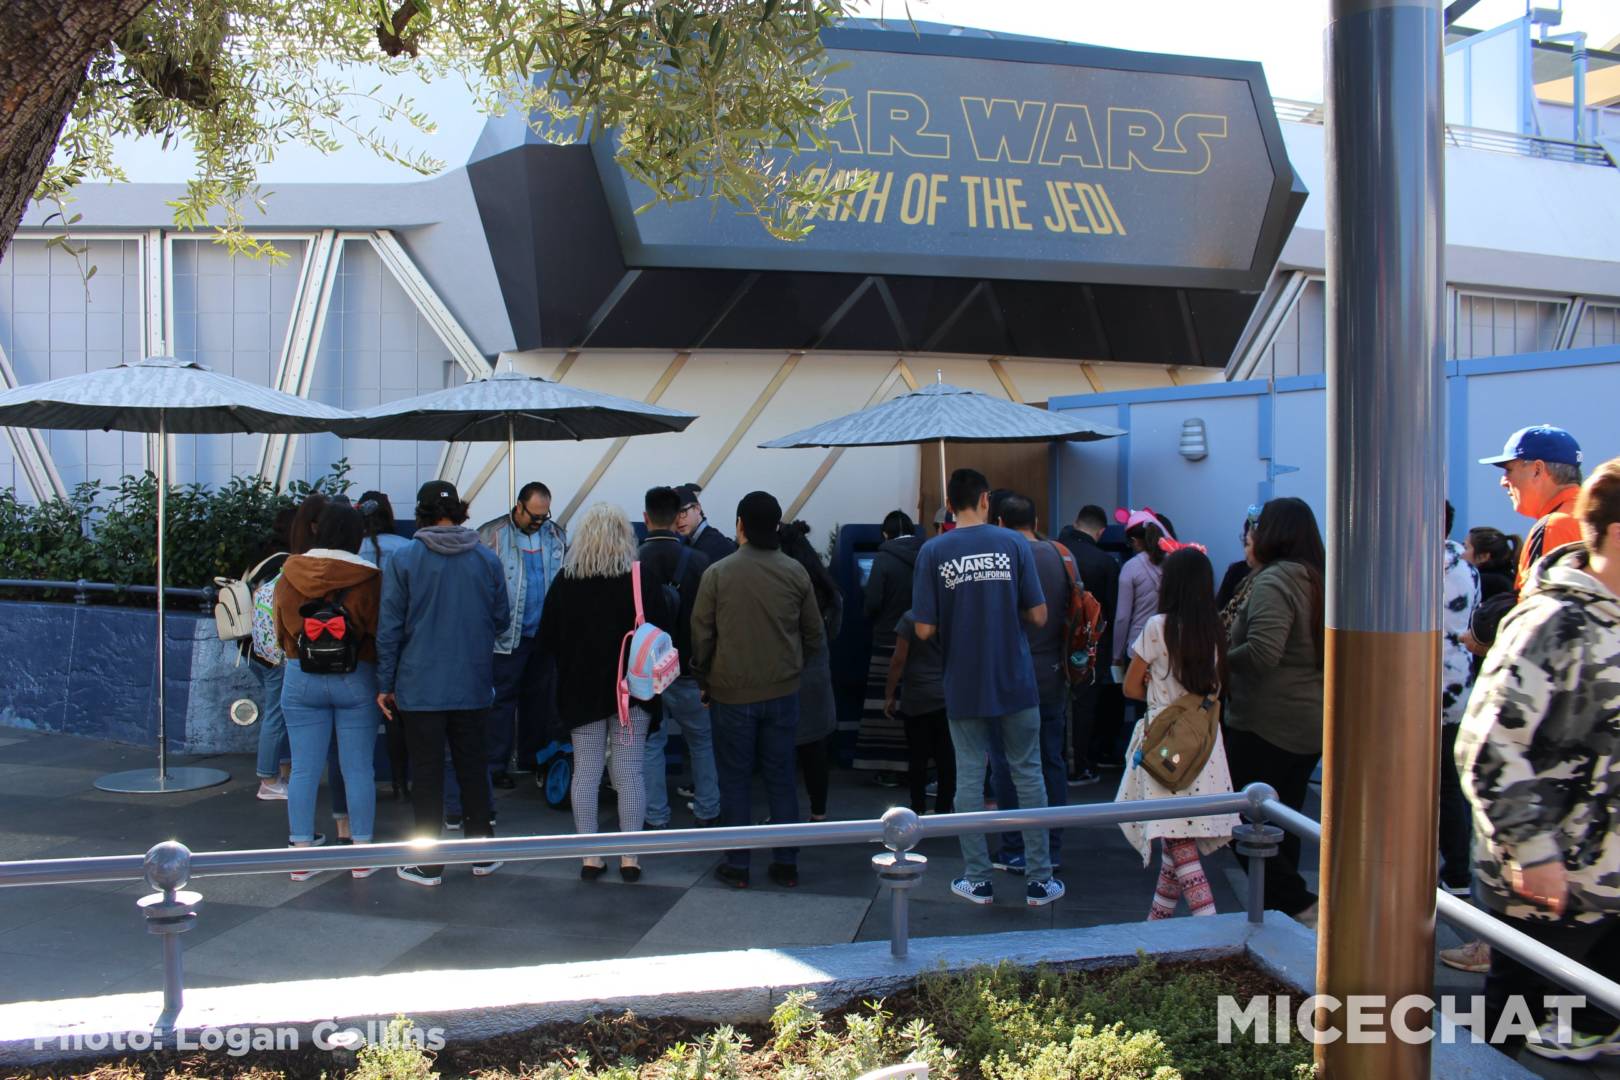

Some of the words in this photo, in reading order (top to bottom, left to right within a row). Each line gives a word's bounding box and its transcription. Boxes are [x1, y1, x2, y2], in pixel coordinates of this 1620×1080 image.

[960, 96, 1228, 176] WARS
[900, 172, 949, 225] OF
[960, 175, 1033, 231] THE
[1043, 180, 1127, 236] JEDI
[951, 552, 995, 574] VANS
[973, 570, 1012, 581] CALIFORNIA
